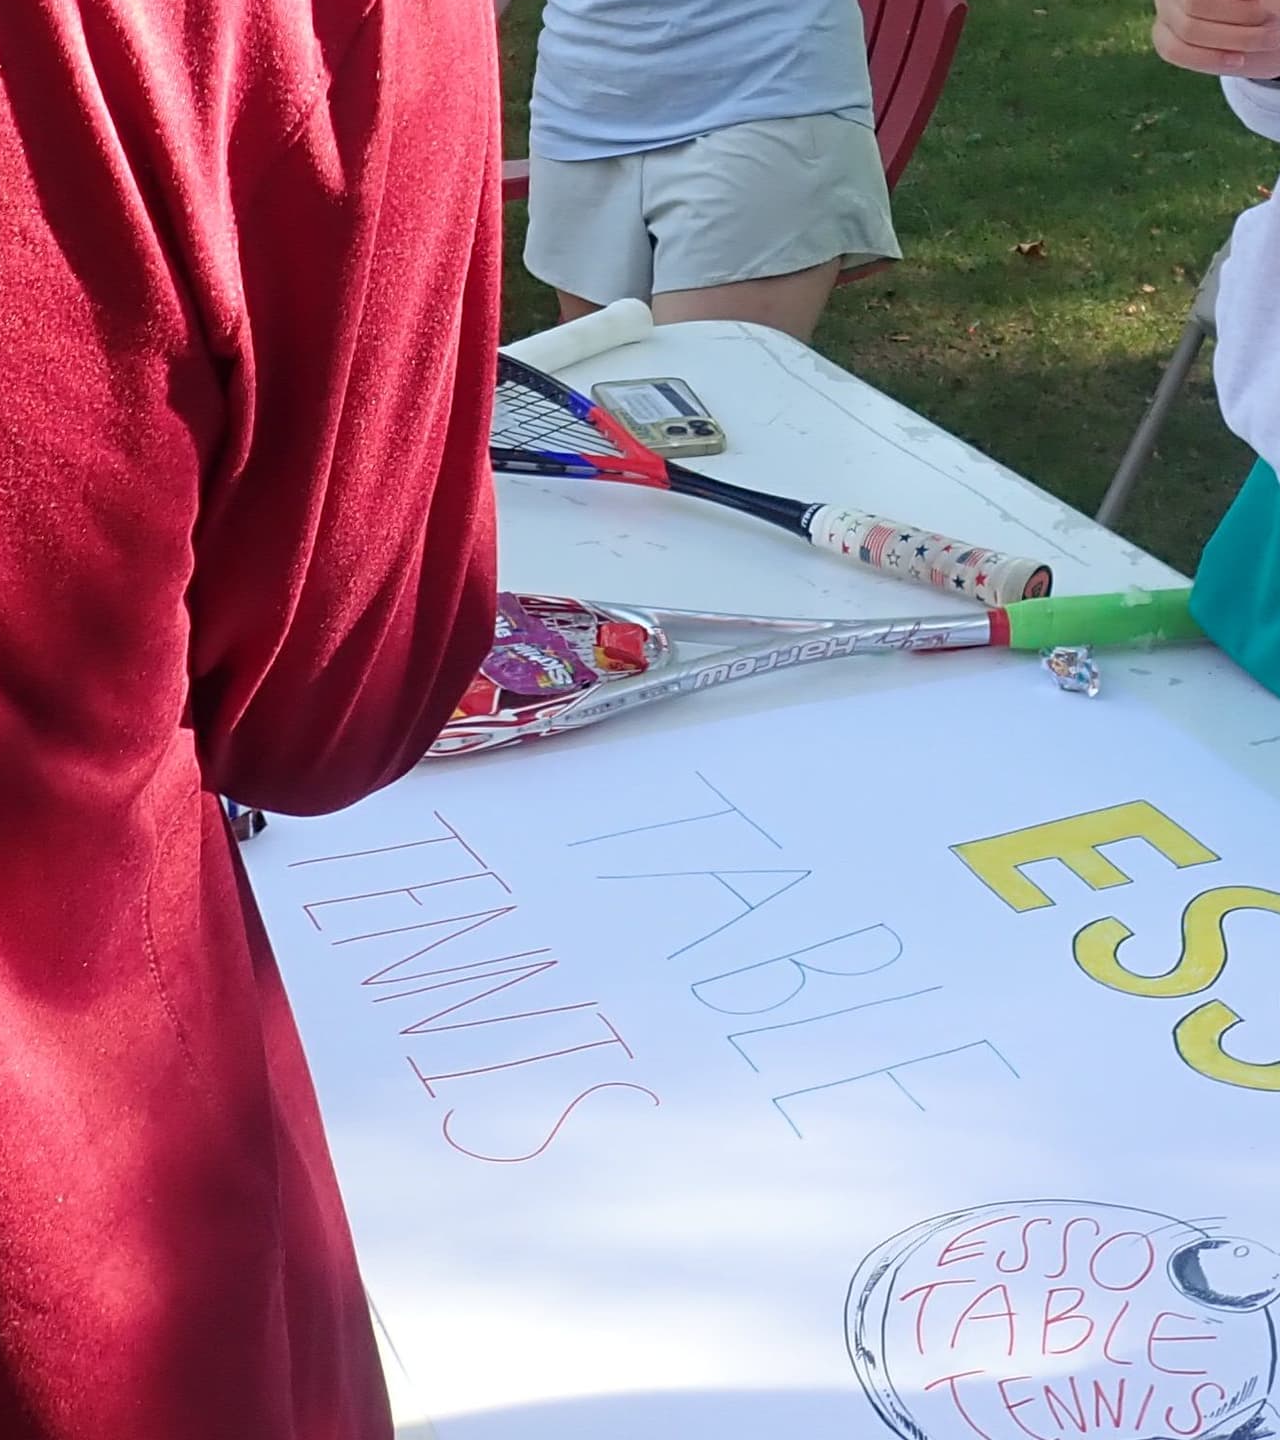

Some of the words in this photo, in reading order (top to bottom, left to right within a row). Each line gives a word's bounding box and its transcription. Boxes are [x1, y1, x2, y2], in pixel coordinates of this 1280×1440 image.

[287, 810, 661, 1162] TENNIS
[568, 770, 1021, 1139] TABLE
[936, 1215, 1155, 1292] ESSO
[898, 1278, 1218, 1375] TABLE
[923, 1369, 1226, 1440] TENNIS
